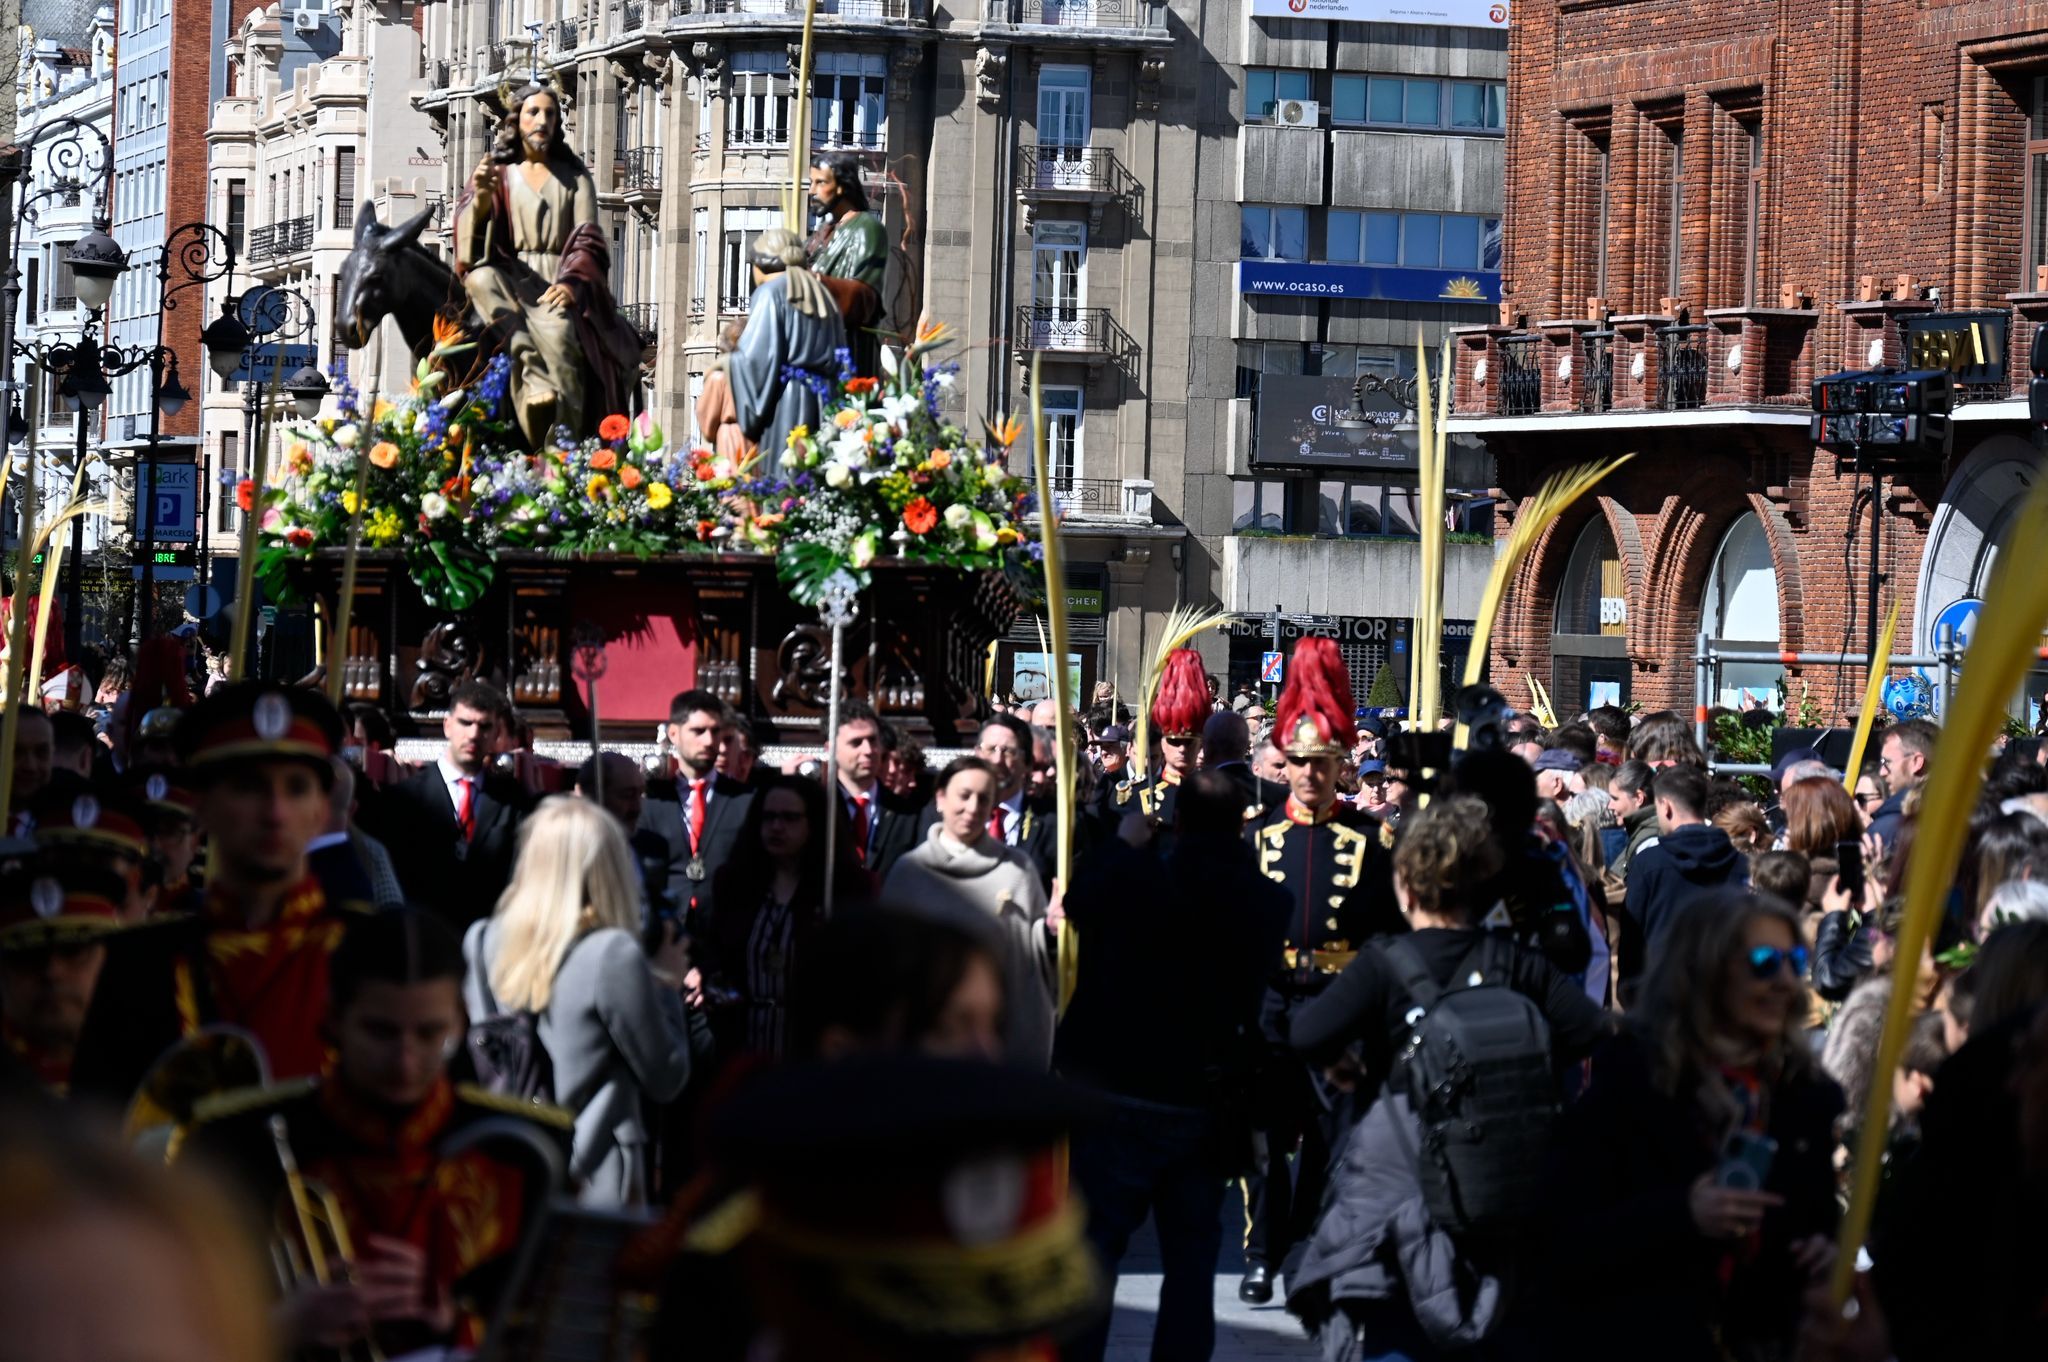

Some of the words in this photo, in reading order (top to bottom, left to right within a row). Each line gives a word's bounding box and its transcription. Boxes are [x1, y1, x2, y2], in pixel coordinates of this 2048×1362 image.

[1309, 3, 1349, 11] nederlanden
[1252, 280, 1344, 293] www.ocaso.es
[154, 529, 193, 538] MARCELO
[153, 552, 176, 563] IBRE
